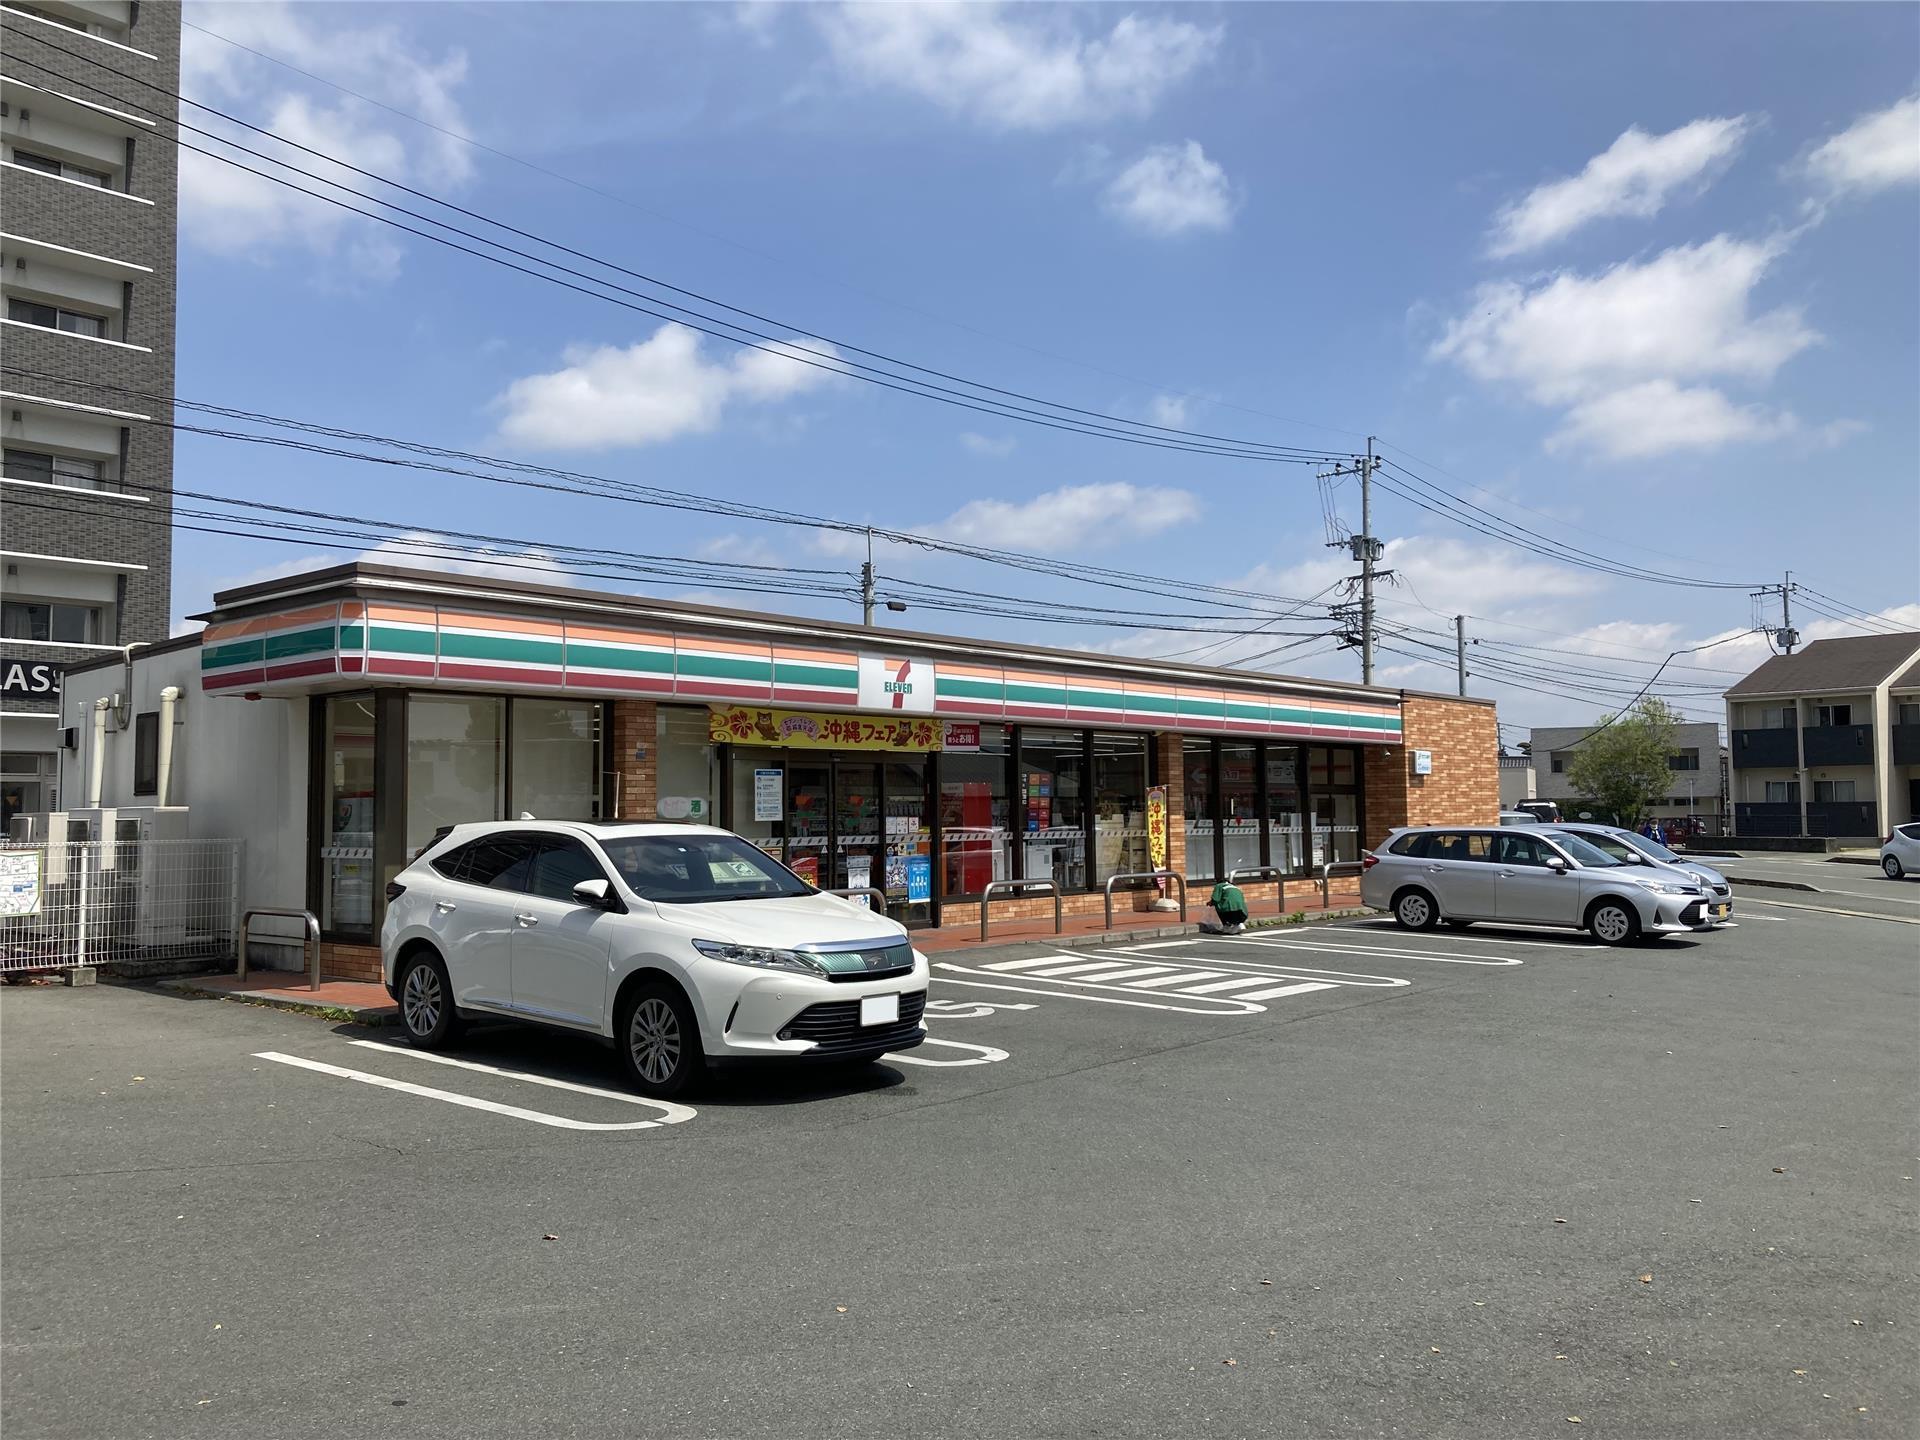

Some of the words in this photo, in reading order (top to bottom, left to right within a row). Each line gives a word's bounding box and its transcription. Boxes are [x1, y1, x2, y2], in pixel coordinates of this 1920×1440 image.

[818, 719, 896, 743] 沖縄フェア
